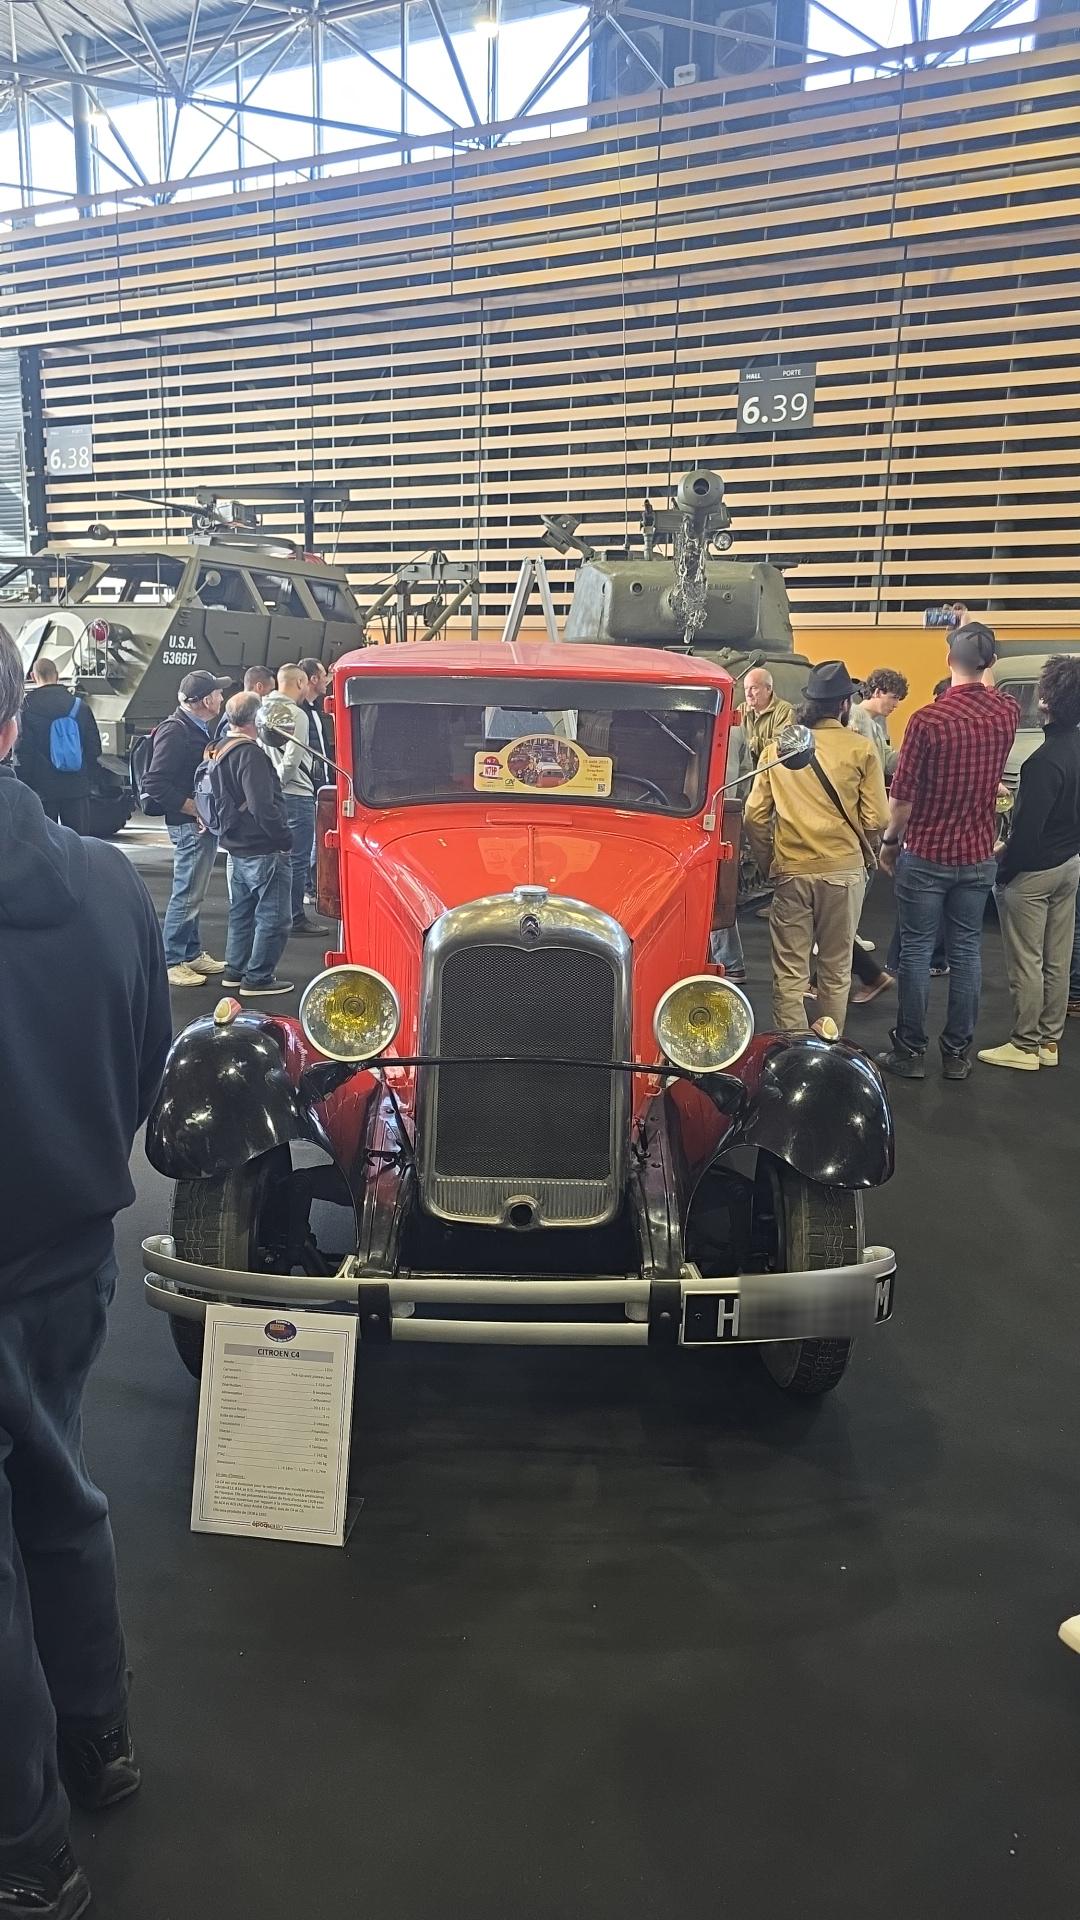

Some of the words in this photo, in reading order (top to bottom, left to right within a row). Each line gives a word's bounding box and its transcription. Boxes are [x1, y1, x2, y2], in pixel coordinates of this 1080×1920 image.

[782, 369, 802, 377] PORTE
[742, 392, 808, 425] 6.39
[50, 446, 89, 469] 6.38
[169, 634, 197, 650] U.S.A.
[162, 651, 198, 666] 536617
[257, 1348, 289, 1358] CITROEN
